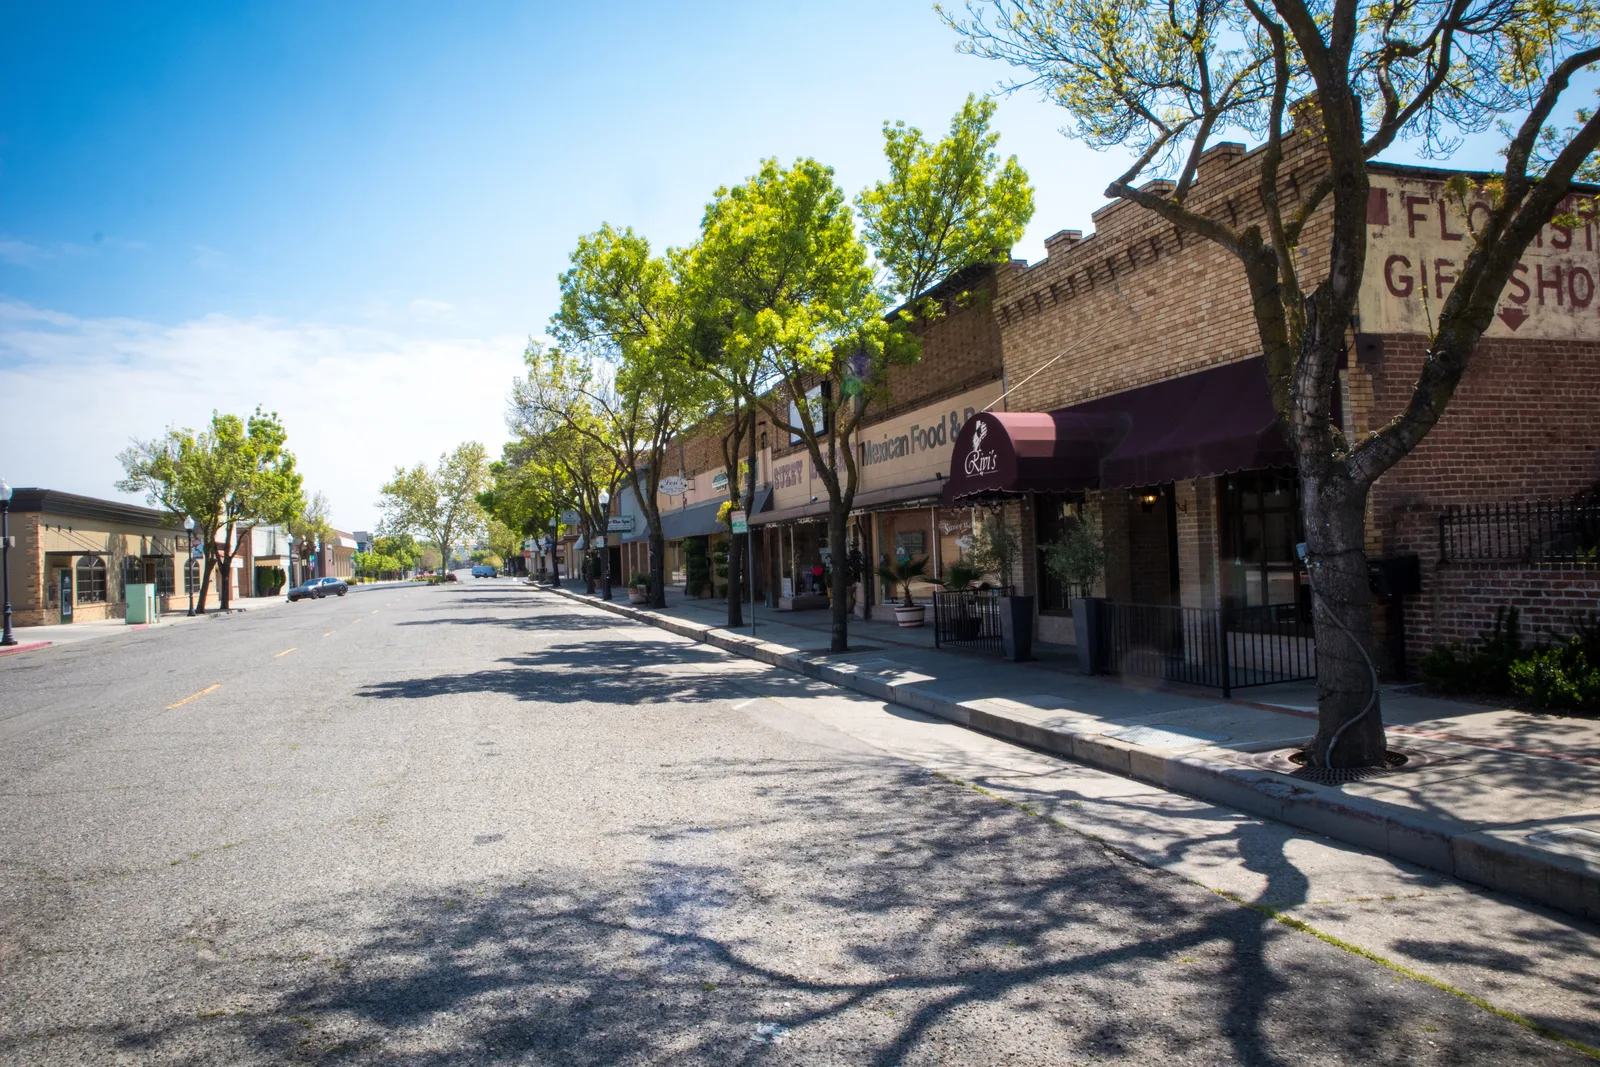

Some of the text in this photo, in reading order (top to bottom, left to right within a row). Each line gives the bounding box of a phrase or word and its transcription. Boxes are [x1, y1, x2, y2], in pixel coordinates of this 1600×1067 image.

[1406, 195, 1596, 252] FLOST
[1384, 254, 1600, 308] GIF SHO
[861, 433, 909, 467] Mexican
[910, 415, 947, 455] Food
[950, 410, 962, 443] &
[773, 460, 803, 490] SUZEY
